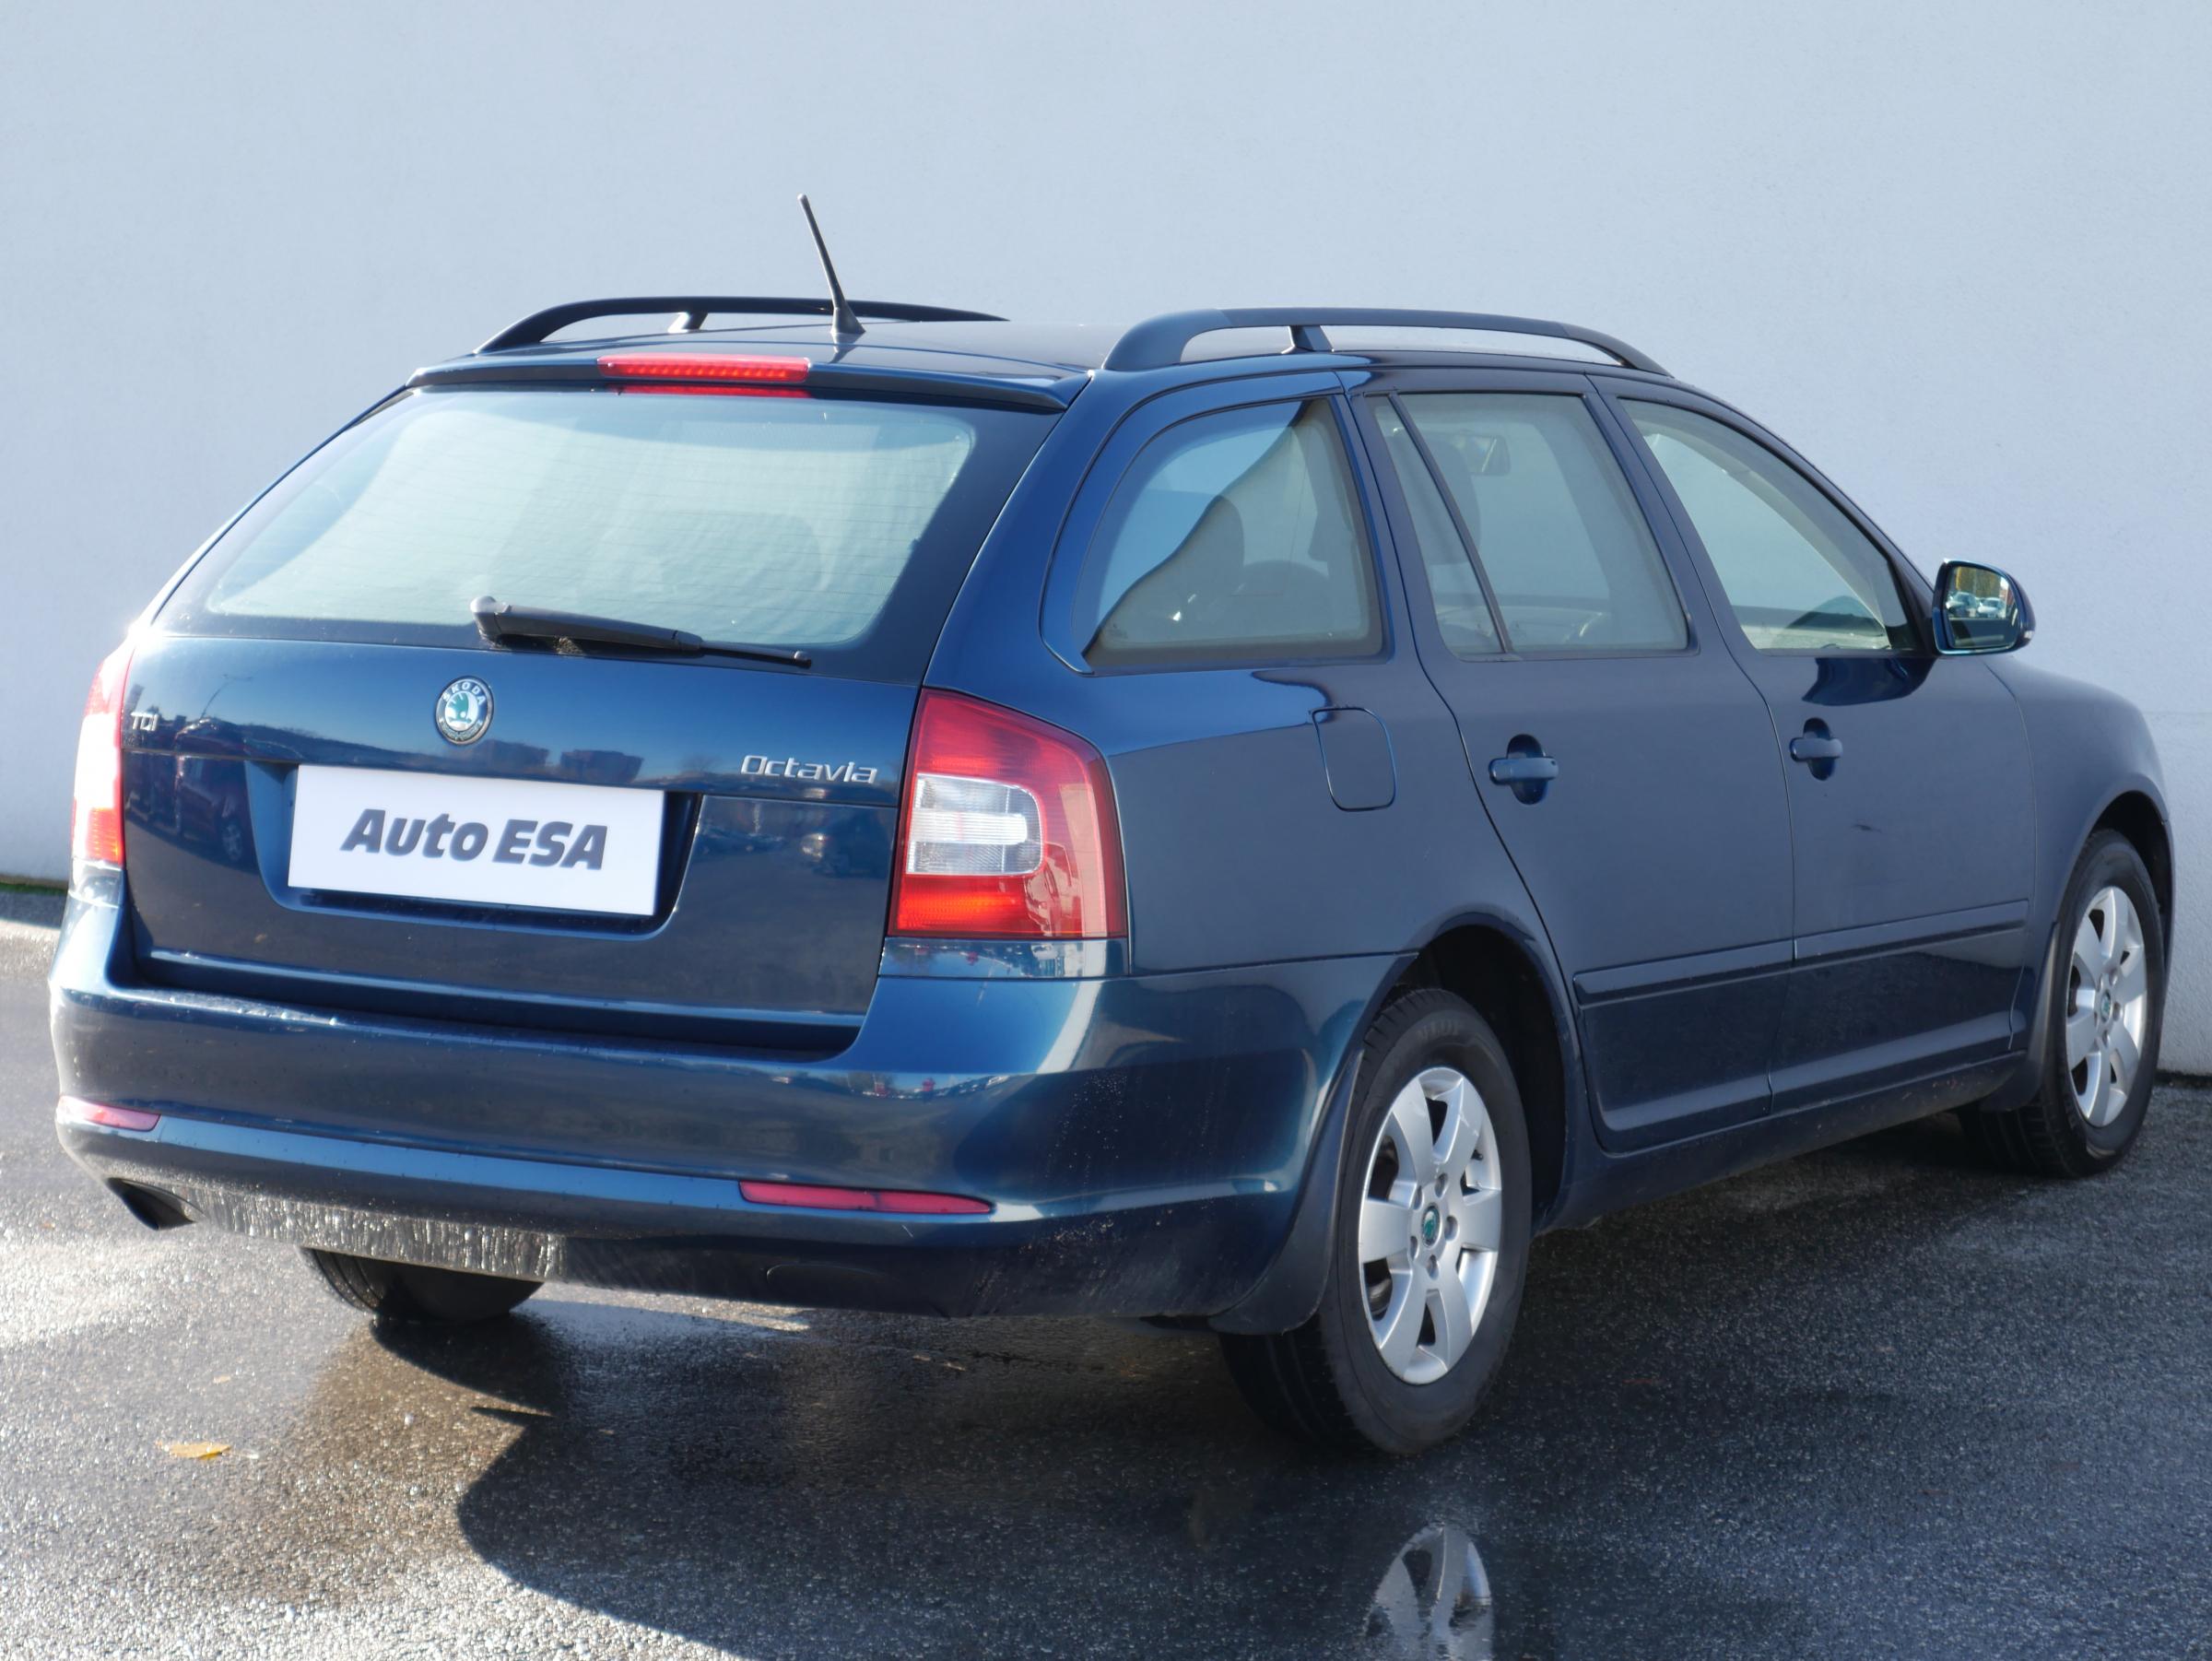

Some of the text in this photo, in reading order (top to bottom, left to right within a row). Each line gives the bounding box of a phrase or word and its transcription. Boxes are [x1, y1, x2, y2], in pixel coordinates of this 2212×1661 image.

[130, 712, 159, 731] TDI
[740, 755, 877, 783] Octavia
[339, 808, 608, 870] Auto ESA
